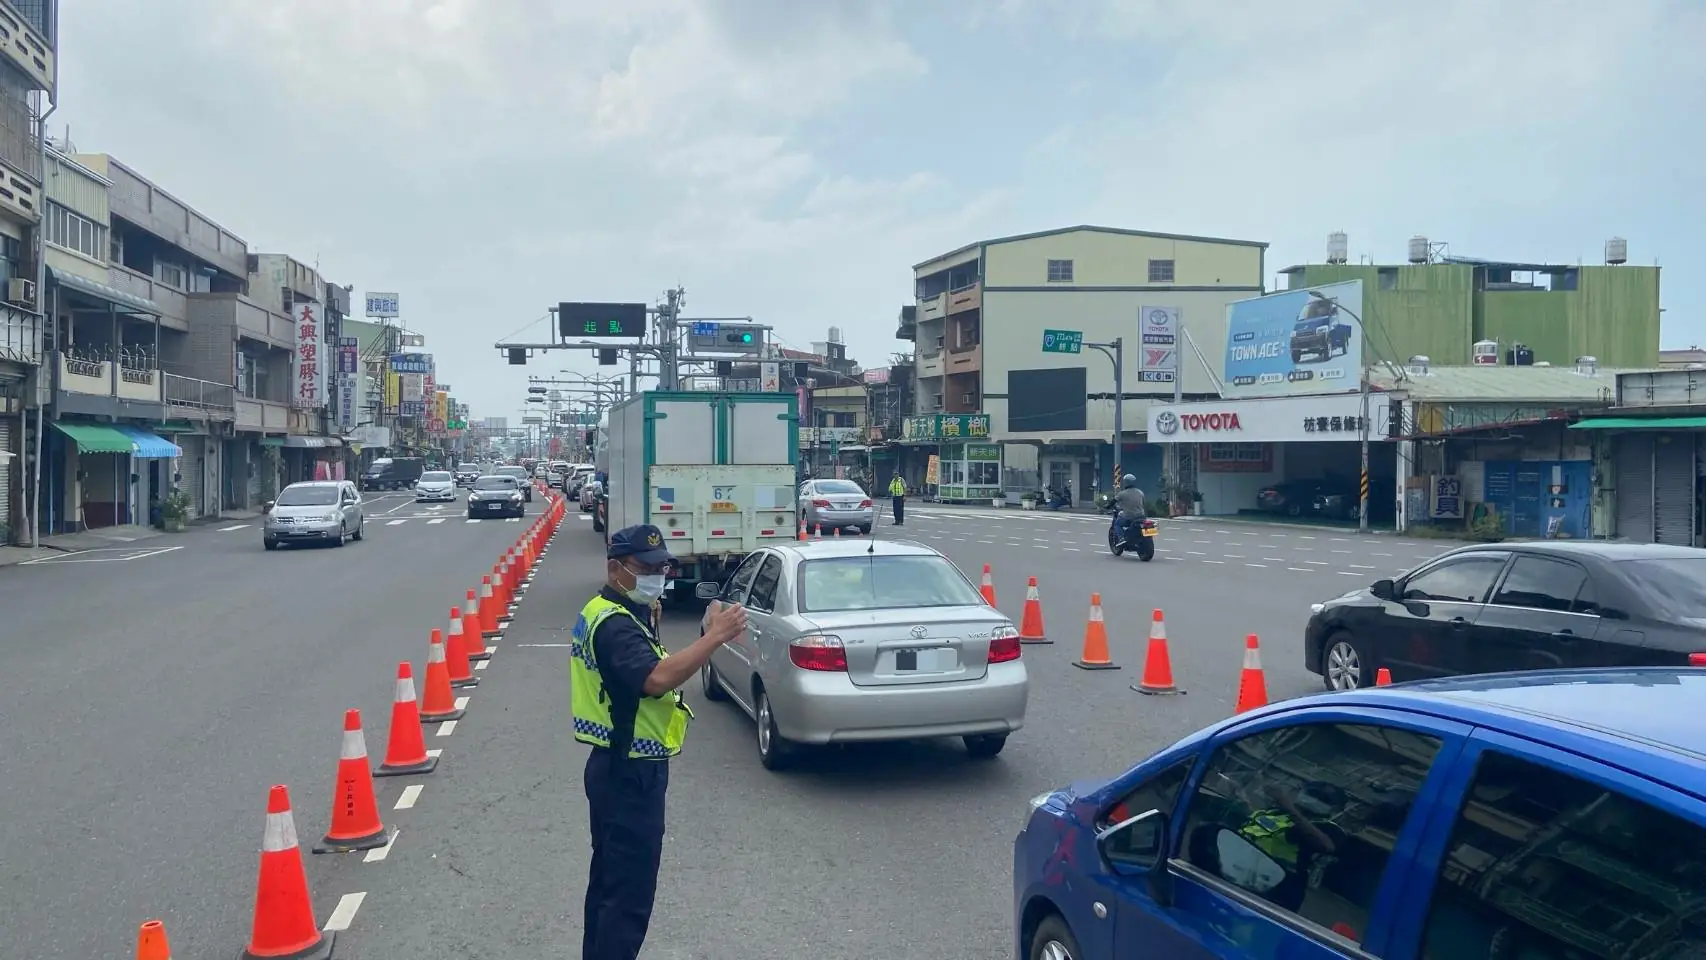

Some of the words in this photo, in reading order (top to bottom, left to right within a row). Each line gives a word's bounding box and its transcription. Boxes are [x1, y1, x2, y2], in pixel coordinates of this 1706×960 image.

[298, 305, 320, 400] 大興塑膠行
[1230, 344, 1257, 361] TOWN
[1257, 341, 1280, 358] ACE
[940, 416, 988, 437] 檳榔
[1180, 413, 1242, 431] TOYOTA
[1435, 476, 1462, 517] 釣具
